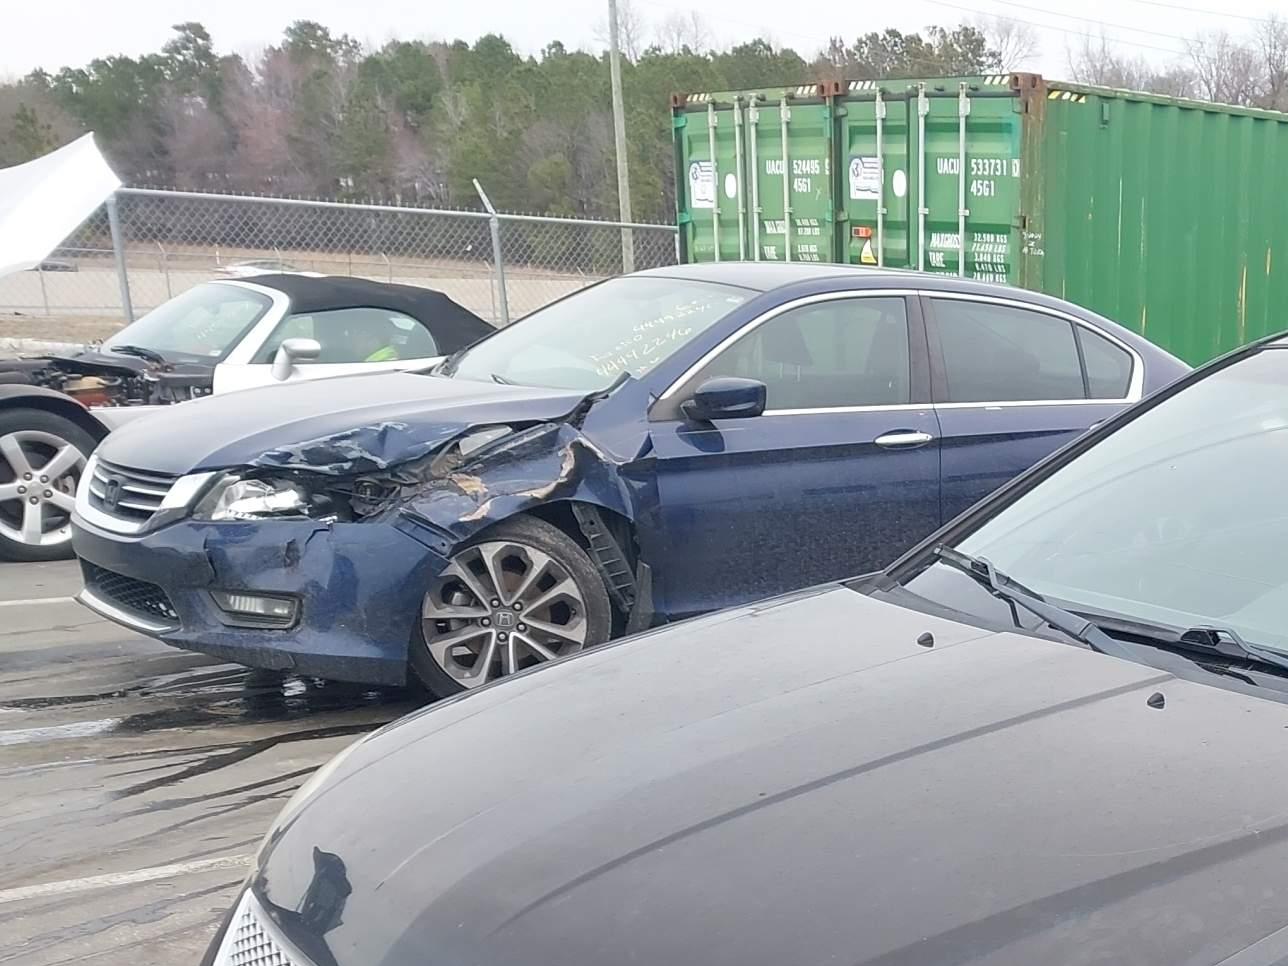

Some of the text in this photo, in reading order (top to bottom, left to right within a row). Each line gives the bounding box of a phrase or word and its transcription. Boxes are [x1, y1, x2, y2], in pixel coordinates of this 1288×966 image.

[793, 160, 820, 174] 524495
[937, 158, 960, 174] UACU
[970, 158, 1007, 176] 533731
[970, 180, 995, 196] 45G1
